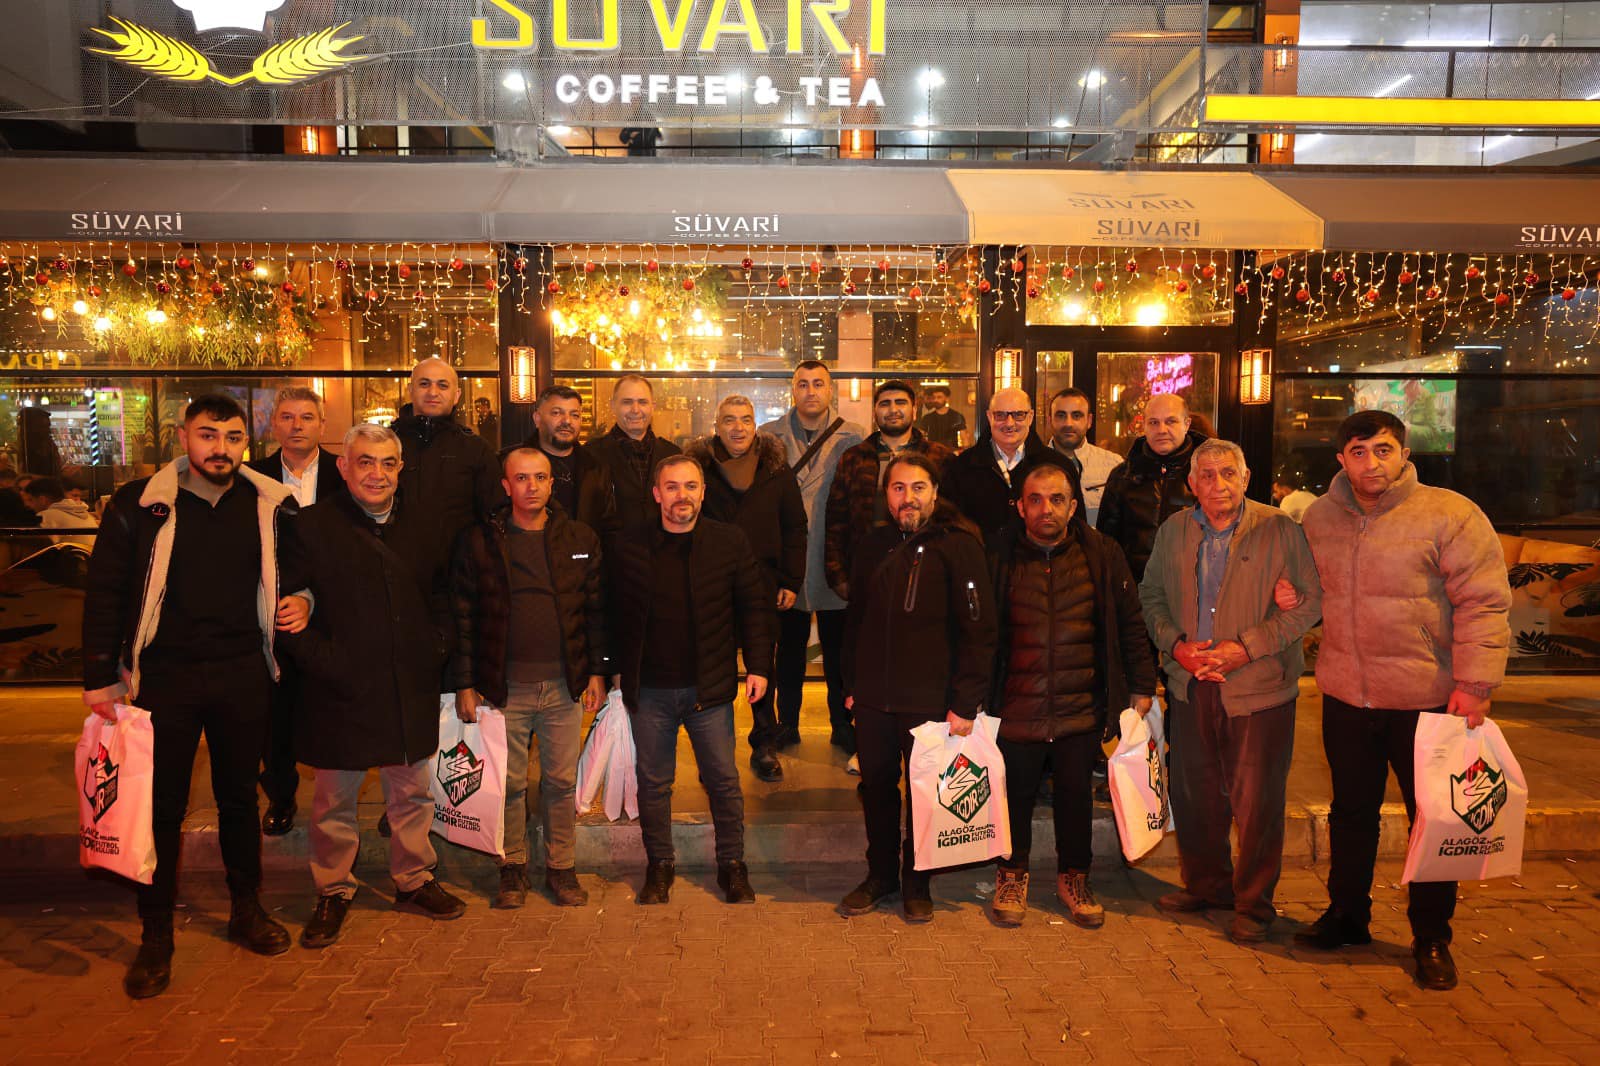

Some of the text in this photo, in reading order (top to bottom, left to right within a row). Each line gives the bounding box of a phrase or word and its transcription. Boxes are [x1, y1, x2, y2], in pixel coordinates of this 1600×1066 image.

[555, 73, 886, 107] COFFEE & TEA
[674, 213, 779, 232] SÜVARİ
[938, 824, 975, 838] ALAGÖZ
